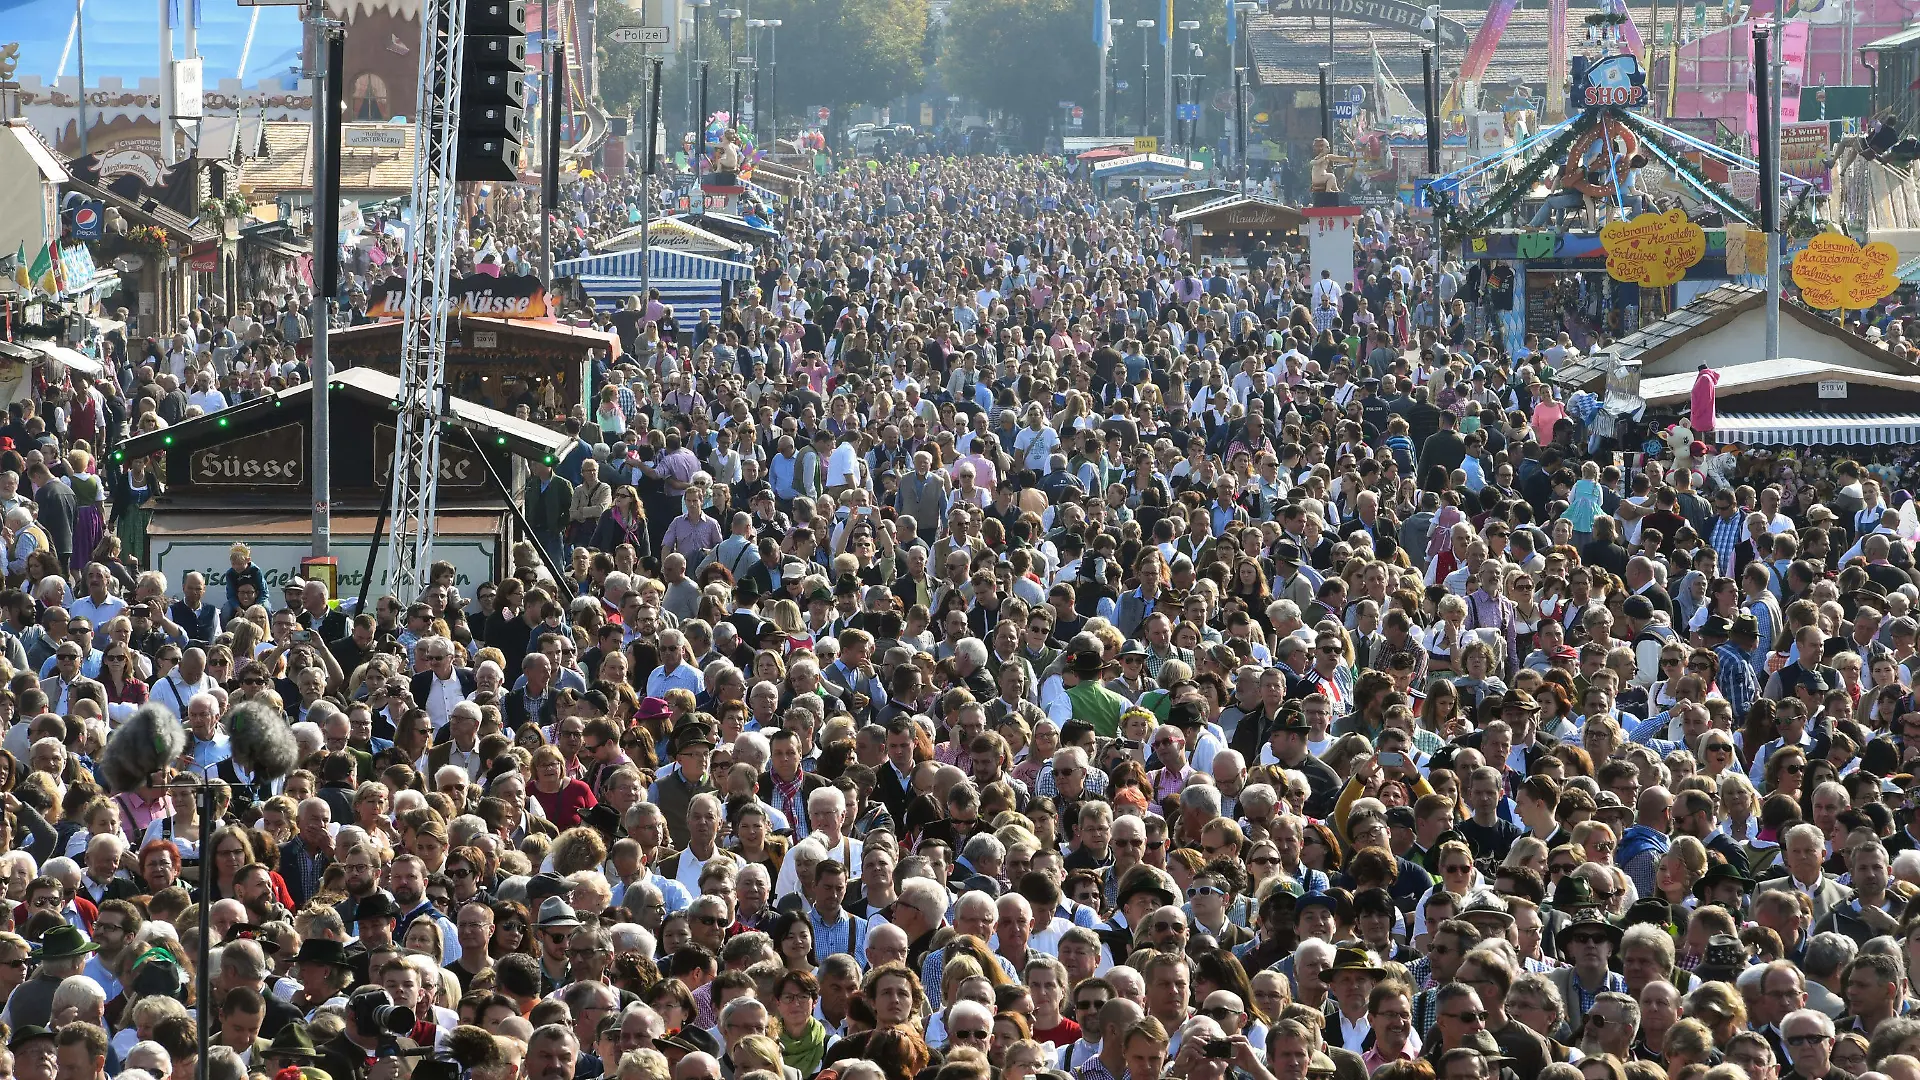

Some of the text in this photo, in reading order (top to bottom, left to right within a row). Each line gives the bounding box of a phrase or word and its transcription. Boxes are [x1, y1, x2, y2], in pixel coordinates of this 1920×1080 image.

[1300, 0, 1424, 29] WILDSTUBE
[624, 30, 662, 40] Polizei
[1585, 86, 1643, 105] SHOP
[1335, 105, 1352, 115] WC
[1138, 140, 1154, 149] TAXI
[1608, 221, 1664, 239] Gebrannte
[1648, 226, 1697, 245] Mandeln
[1811, 240, 1858, 254] Gebrannte
[1800, 252, 1862, 264] Macadamia
[1617, 262, 1647, 277] Para
[1795, 265, 1842, 284] Walnüsse
[463, 288, 531, 313] Nüsse
[200, 452, 297, 478] Süsse
